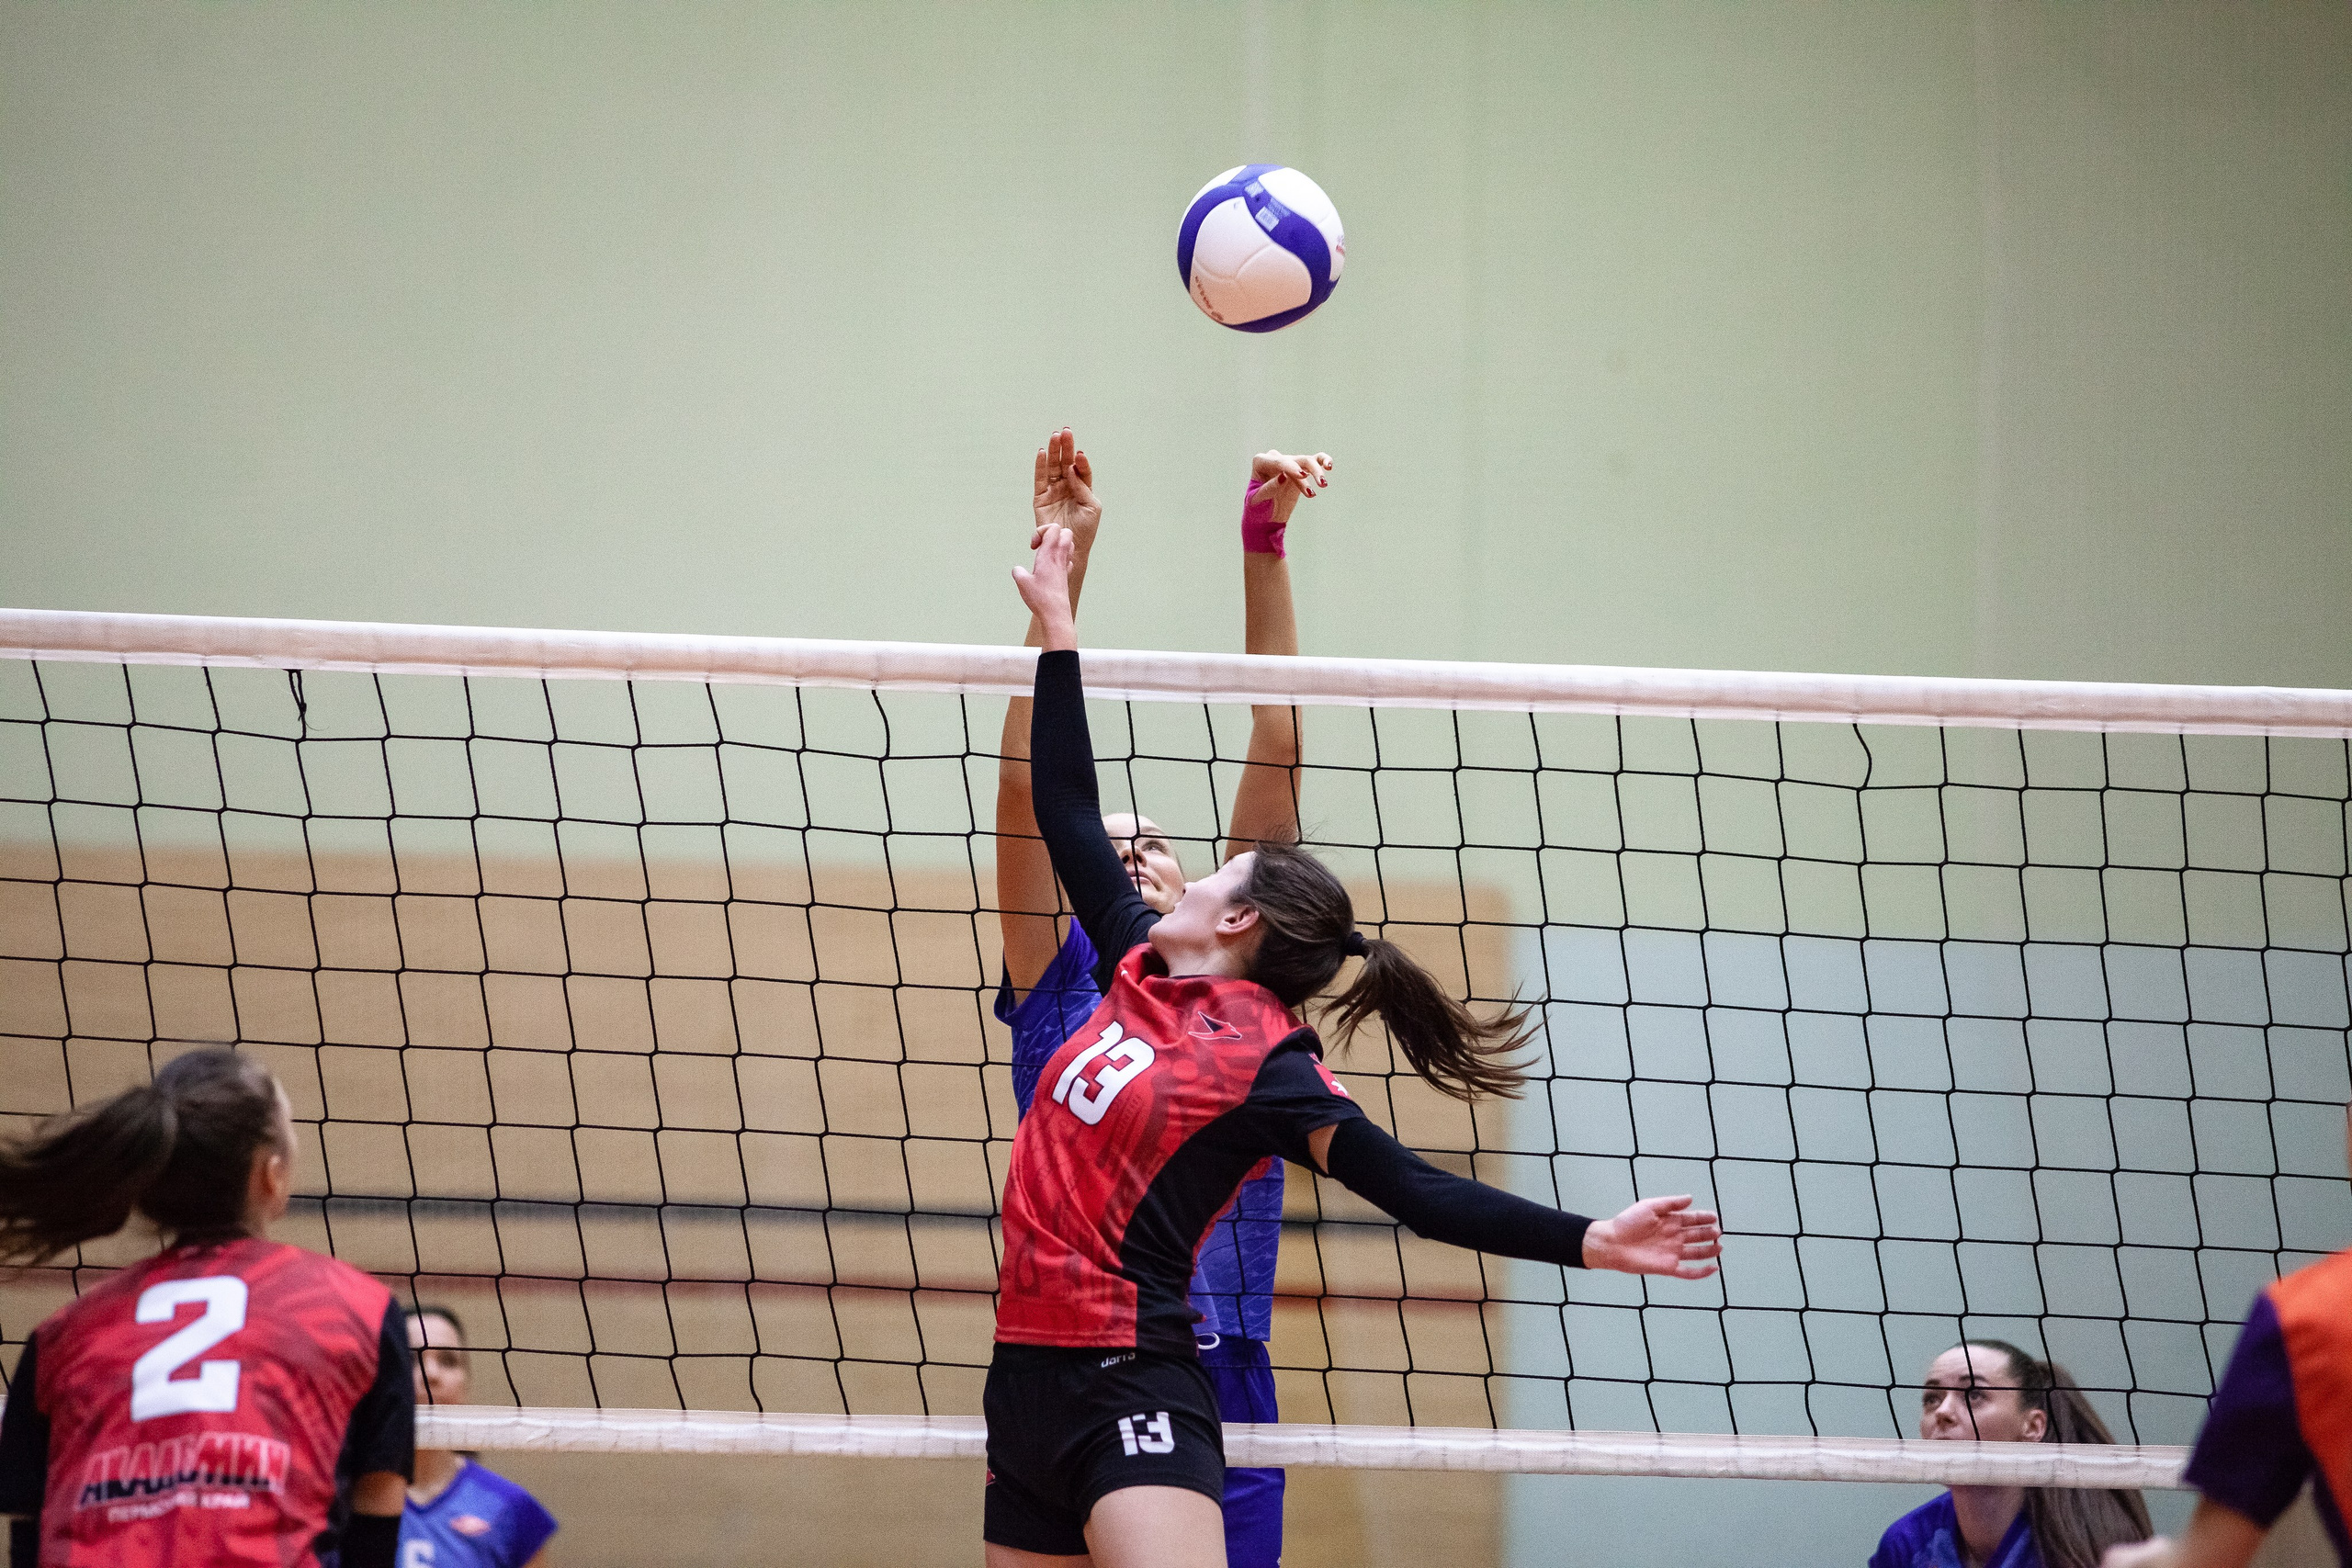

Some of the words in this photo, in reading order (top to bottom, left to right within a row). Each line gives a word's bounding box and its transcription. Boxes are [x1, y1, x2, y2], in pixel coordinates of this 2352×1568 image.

[1052, 1021, 1156, 1125] 13
[130, 1275, 249, 1422] 2
[1117, 1411, 1175, 1456] 13
